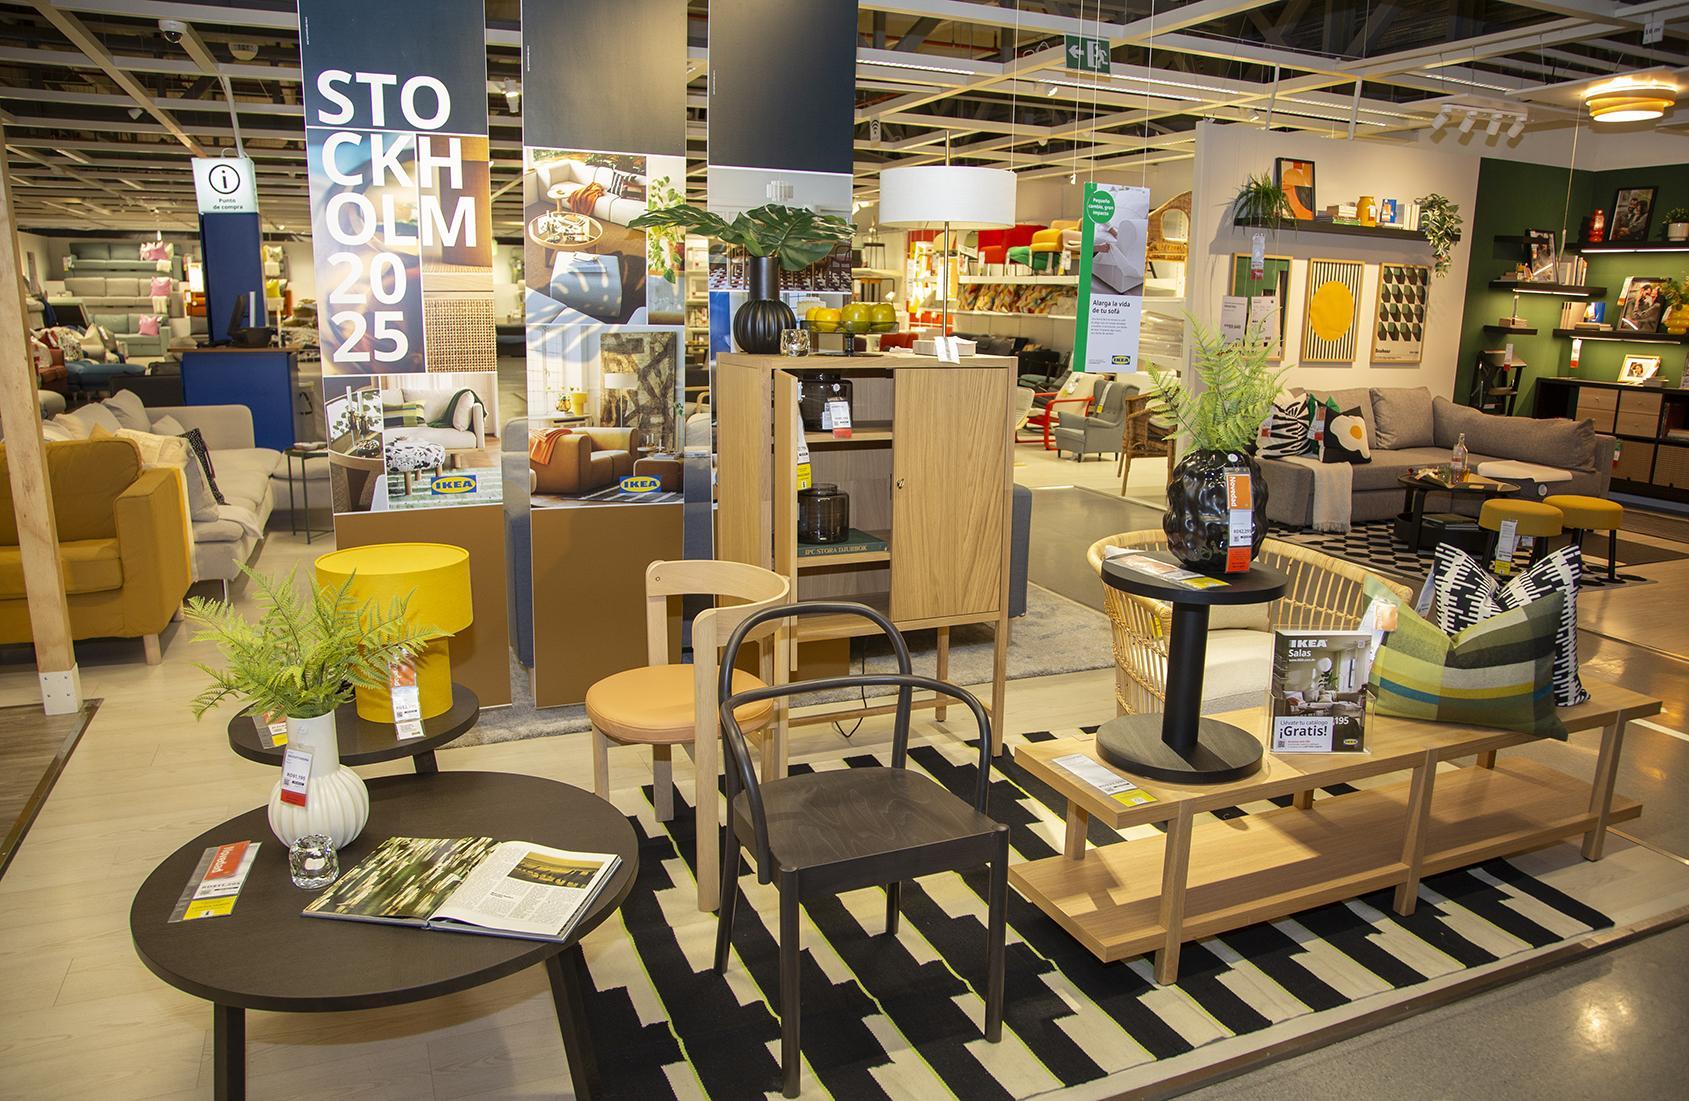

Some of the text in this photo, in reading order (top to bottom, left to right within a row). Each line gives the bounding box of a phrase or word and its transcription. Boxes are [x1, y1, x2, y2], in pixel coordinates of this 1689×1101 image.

[317, 70, 451, 130] STO
[322, 132, 463, 189] CKH
[326, 192, 477, 247] OLM
[327, 252, 407, 305] 20
[1093, 300, 1111, 308] Alarga
[330, 310, 409, 363] 25
[435, 480, 473, 489] IKEA
[1229, 476, 1238, 507] Novedad
[1288, 639, 1328, 648] IKEA
[1288, 649, 1311, 657] Salas
[1280, 725, 1328, 739] ¡Gratis!
[1306, 719, 1328, 727] catálogo
[211, 846, 235, 874] Novedad
